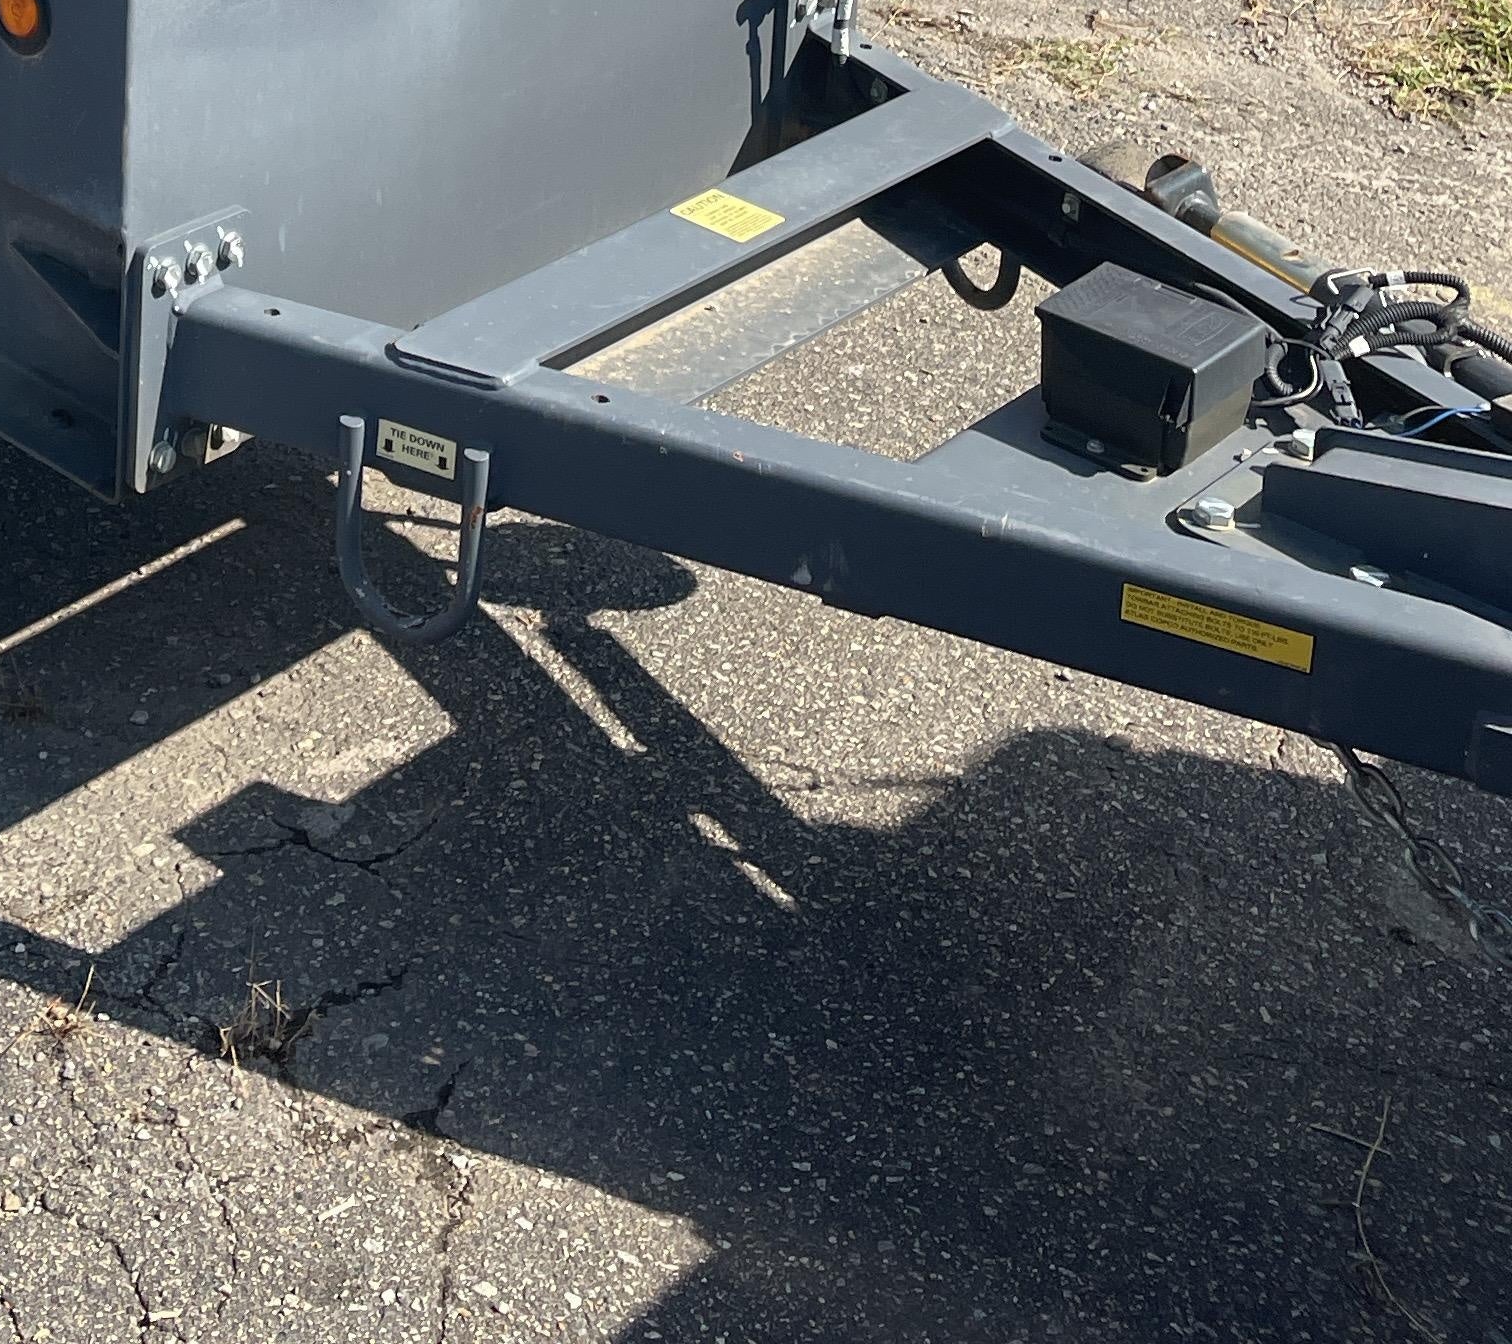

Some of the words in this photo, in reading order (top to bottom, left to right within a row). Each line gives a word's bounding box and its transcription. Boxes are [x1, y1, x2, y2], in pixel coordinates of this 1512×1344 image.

[678, 192, 726, 216] CAUTION
[390, 427, 407, 440] TIE
[409, 434, 445, 452] DOWN
[402, 444, 430, 460] HERE
